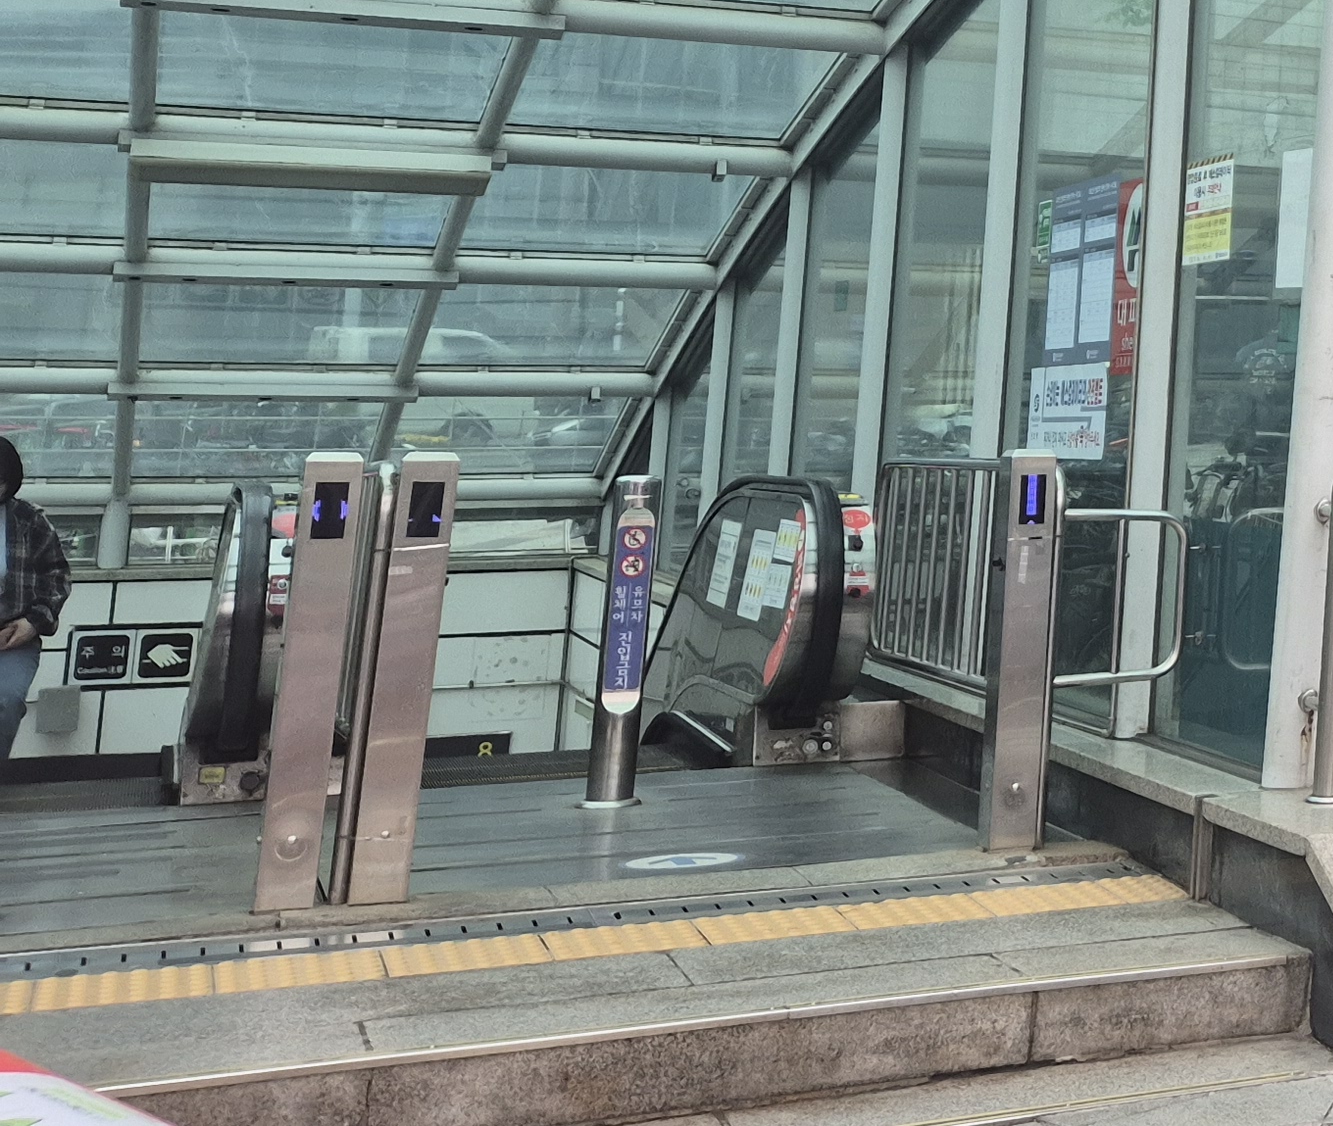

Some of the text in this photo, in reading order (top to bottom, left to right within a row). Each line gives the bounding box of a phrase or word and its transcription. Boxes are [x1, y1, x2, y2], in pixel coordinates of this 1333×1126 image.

[612, 585, 628, 624] 휠체어
[630, 585, 646, 624] 유모차
[81, 645, 126, 660] 주의
[613, 630, 633, 690] 진입금지
